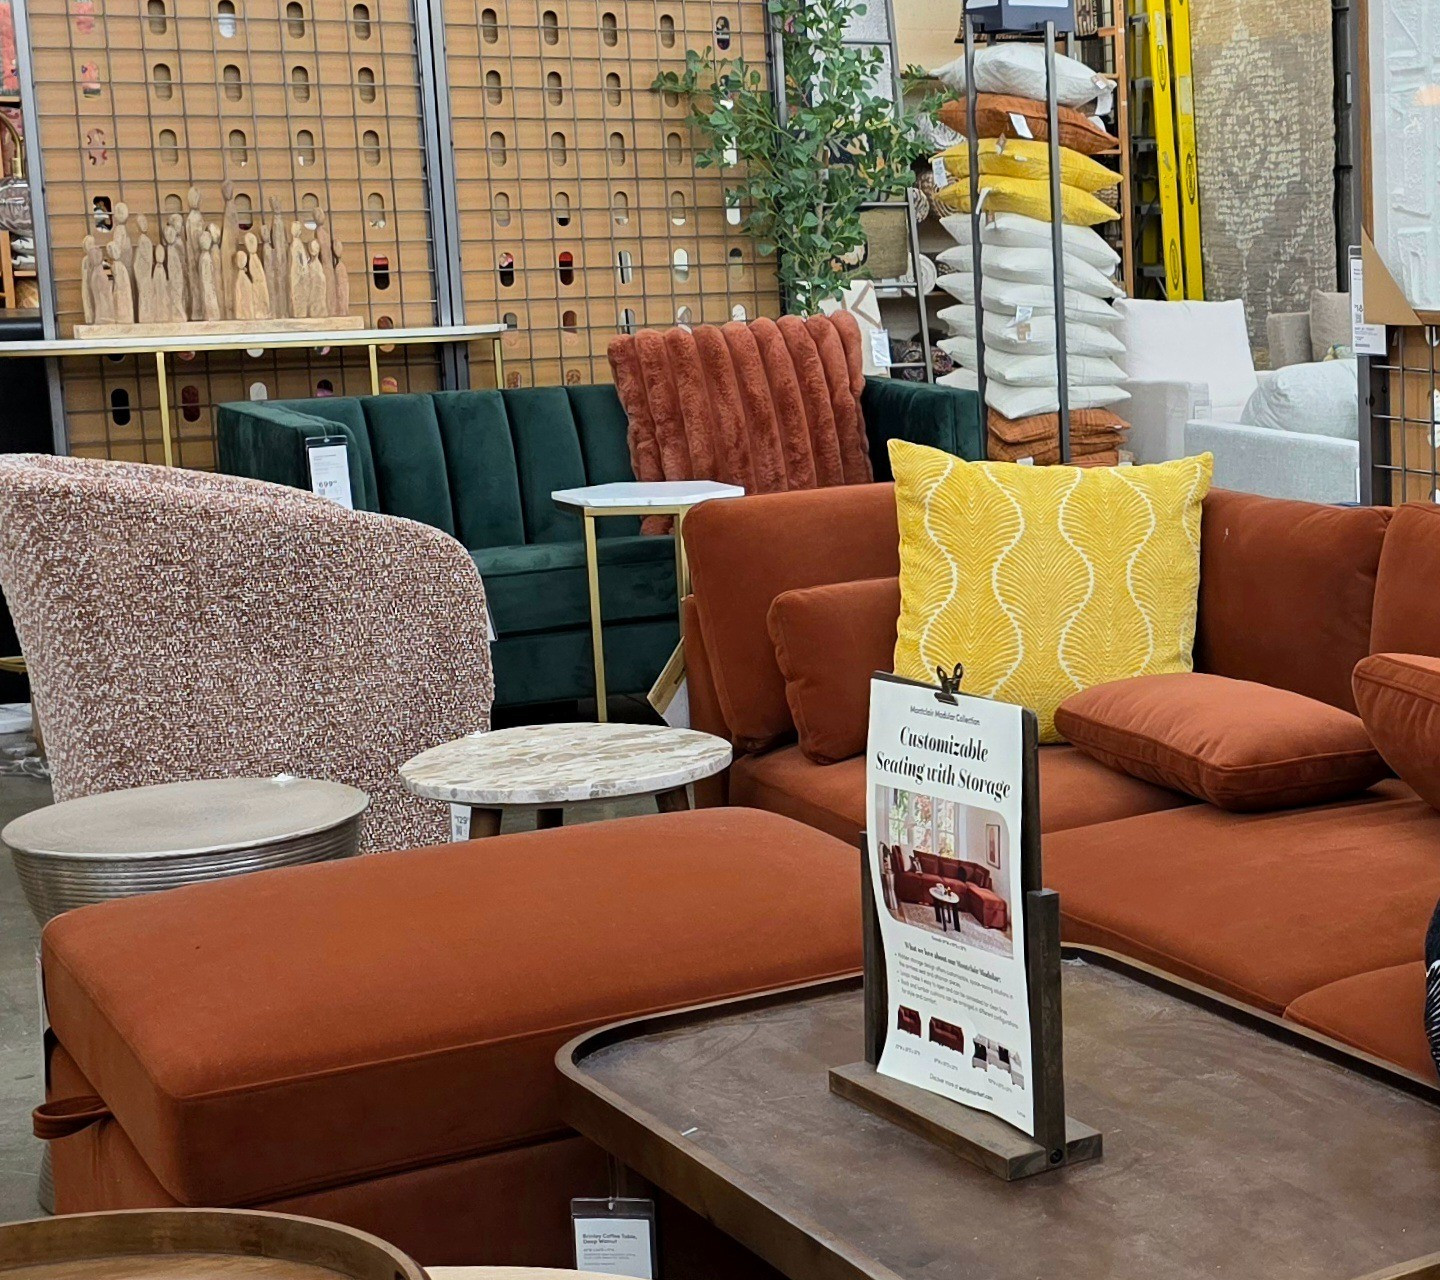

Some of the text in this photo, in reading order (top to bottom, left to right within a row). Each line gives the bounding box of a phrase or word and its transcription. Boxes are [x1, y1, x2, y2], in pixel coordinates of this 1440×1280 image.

[900, 726, 989, 762] Customizable
[876, 751, 1011, 803] Seating with Storage
